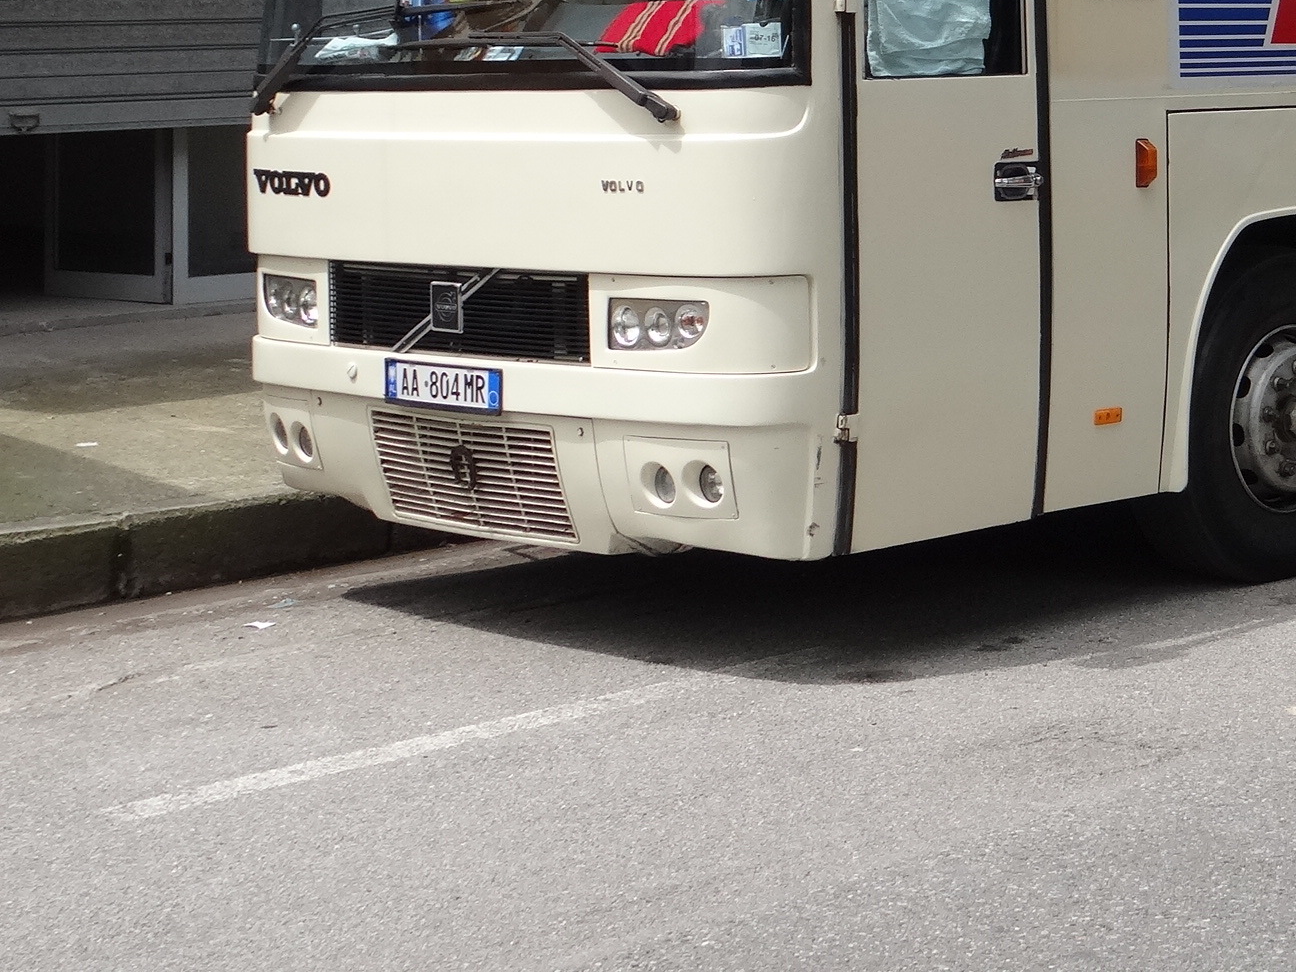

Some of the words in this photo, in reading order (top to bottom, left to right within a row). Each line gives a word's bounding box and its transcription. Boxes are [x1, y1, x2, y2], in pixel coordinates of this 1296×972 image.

[253, 169, 331, 197] VOLVO
[601, 180, 645, 194] VOLVO
[401, 368, 420, 397] AA
